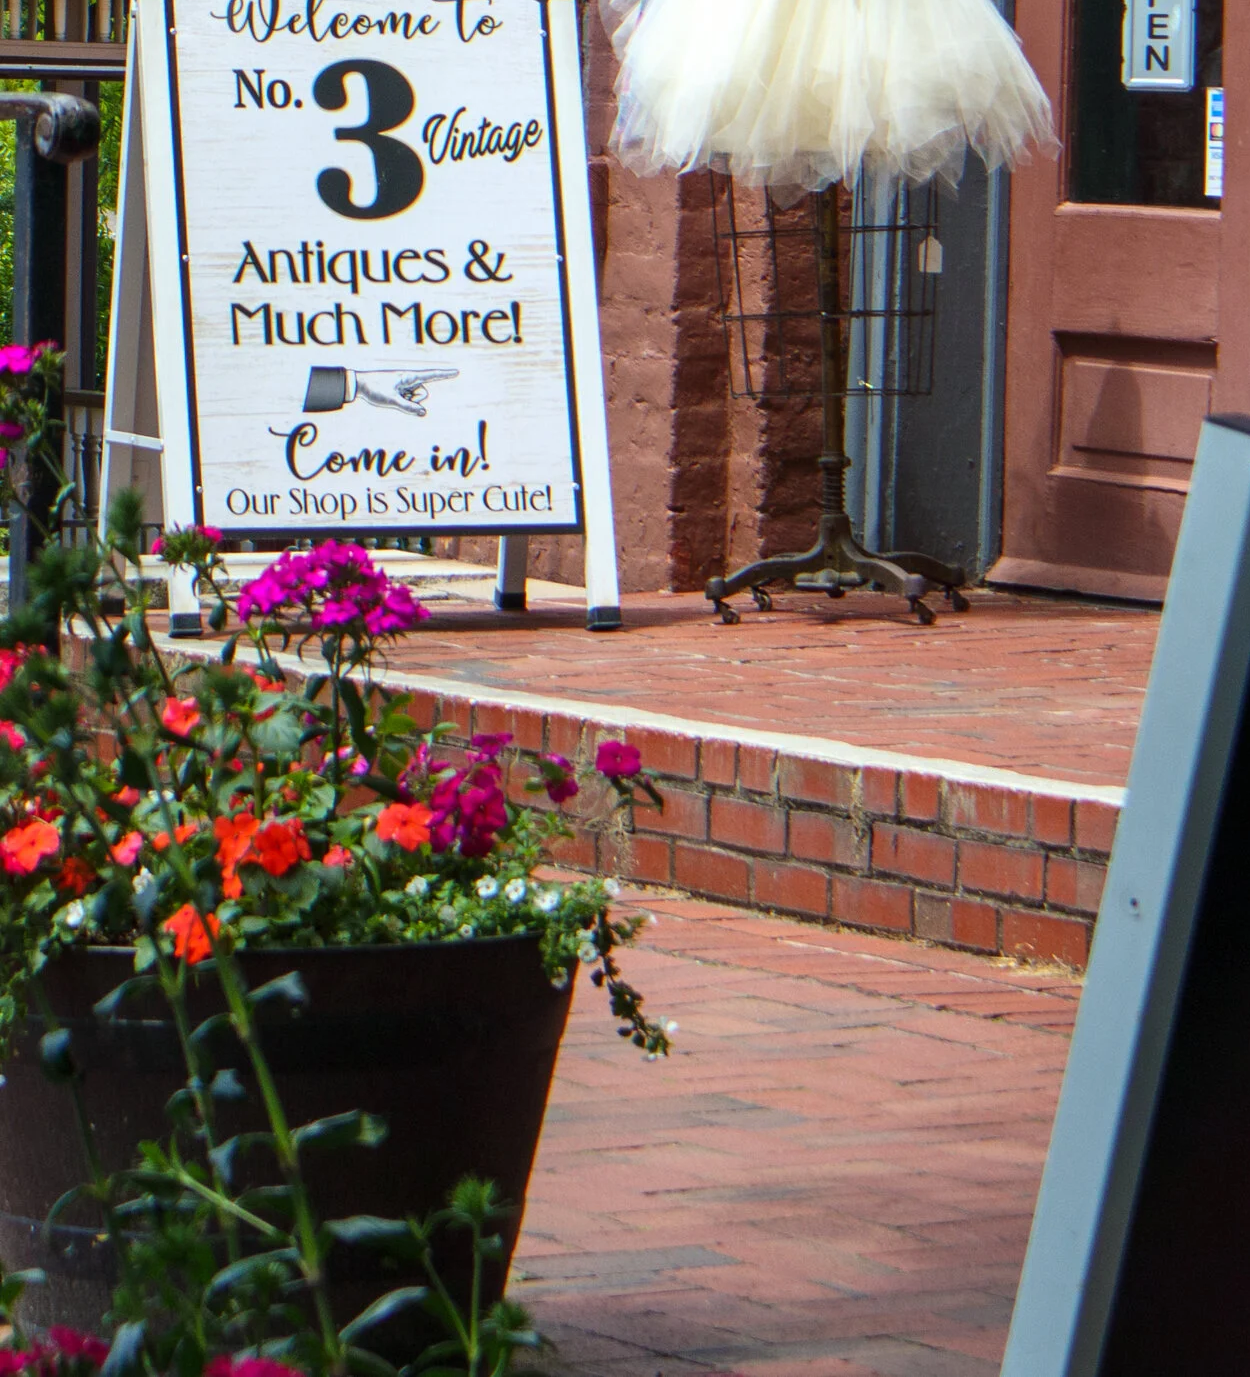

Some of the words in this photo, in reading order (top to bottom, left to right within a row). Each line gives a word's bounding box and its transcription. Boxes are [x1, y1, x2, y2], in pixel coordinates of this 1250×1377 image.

[232, 69, 304, 110] No.
[312, 58, 425, 221] 3
[422, 107, 543, 165] Vintage
[232, 241, 452, 294] Antiques
[464, 240, 513, 284] &
[231, 302, 368, 346] Much
[382, 301, 523, 345] More!
[268, 422, 415, 481] Come
[431, 420, 491, 478] in!
[226, 488, 282, 516] Our
[288, 488, 357, 521] Shop
[366, 486, 388, 514] is
[396, 486, 475, 520] Super
[483, 485, 553, 513] Cute!
